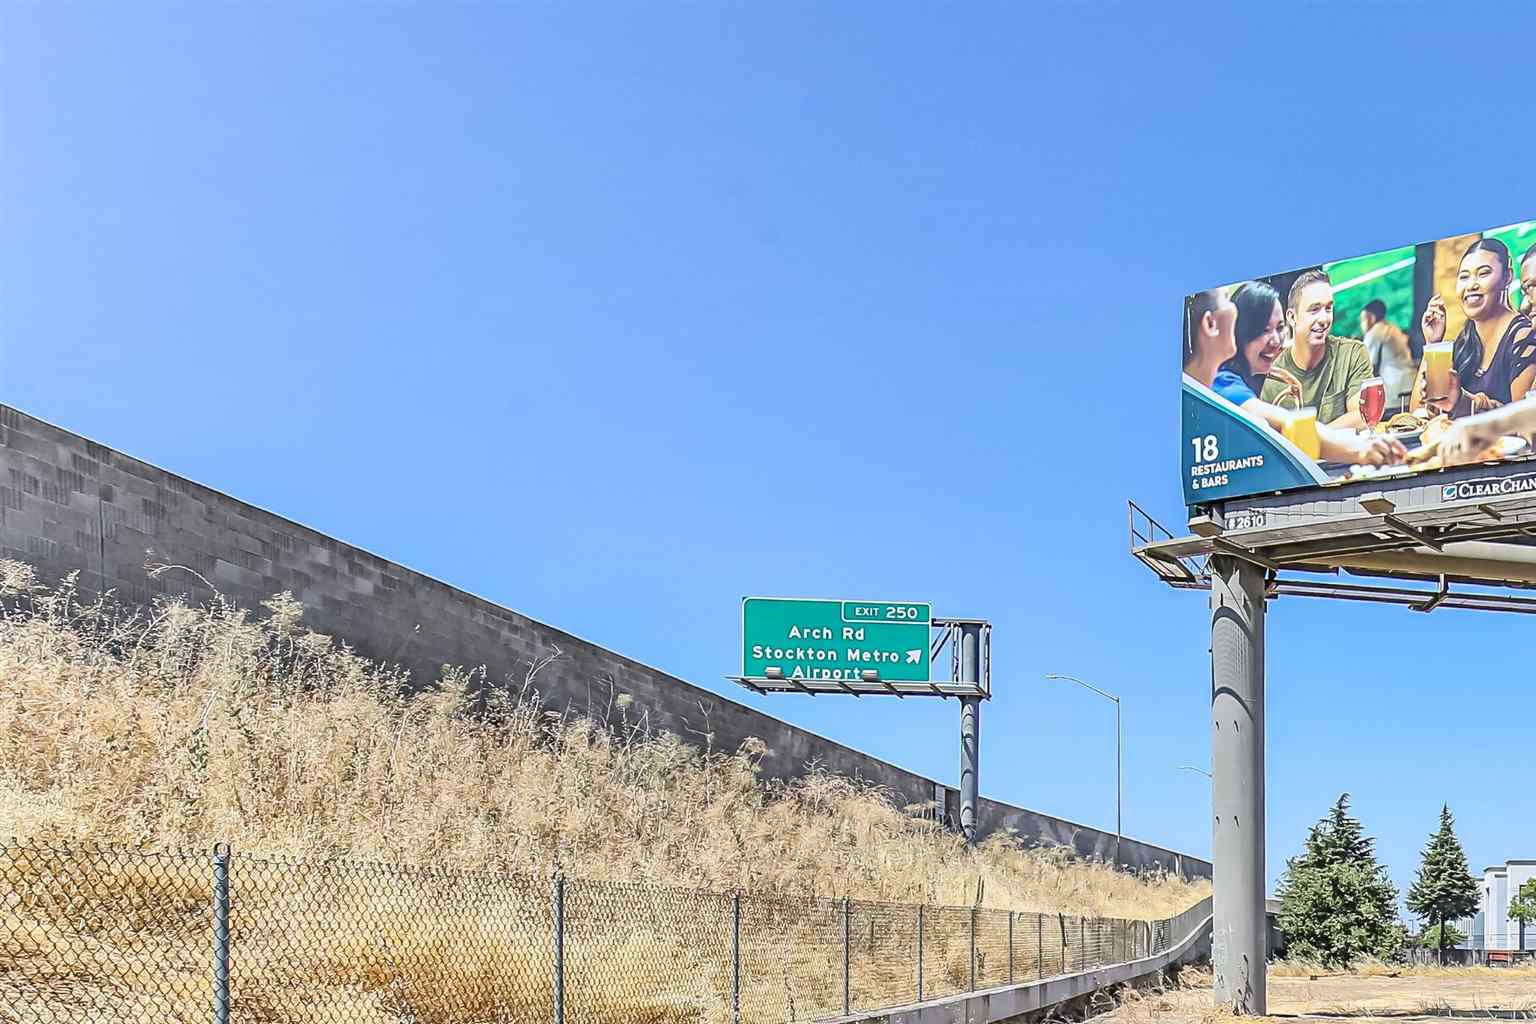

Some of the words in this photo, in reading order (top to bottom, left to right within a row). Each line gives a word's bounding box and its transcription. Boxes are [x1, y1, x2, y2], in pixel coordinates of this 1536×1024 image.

[1191, 434, 1219, 464] 18
[1191, 455, 1264, 477] RESTAURANTS
[1192, 478, 1200, 490] &
[1201, 474, 1229, 489] BARS
[855, 607, 880, 617] EXIT
[886, 606, 918, 620] 250
[788, 625, 833, 640] Arch
[842, 627, 865, 641] Rd
[752, 645, 837, 661] Stockton
[847, 648, 899, 663] Metro
[791, 665, 861, 680] Airport
